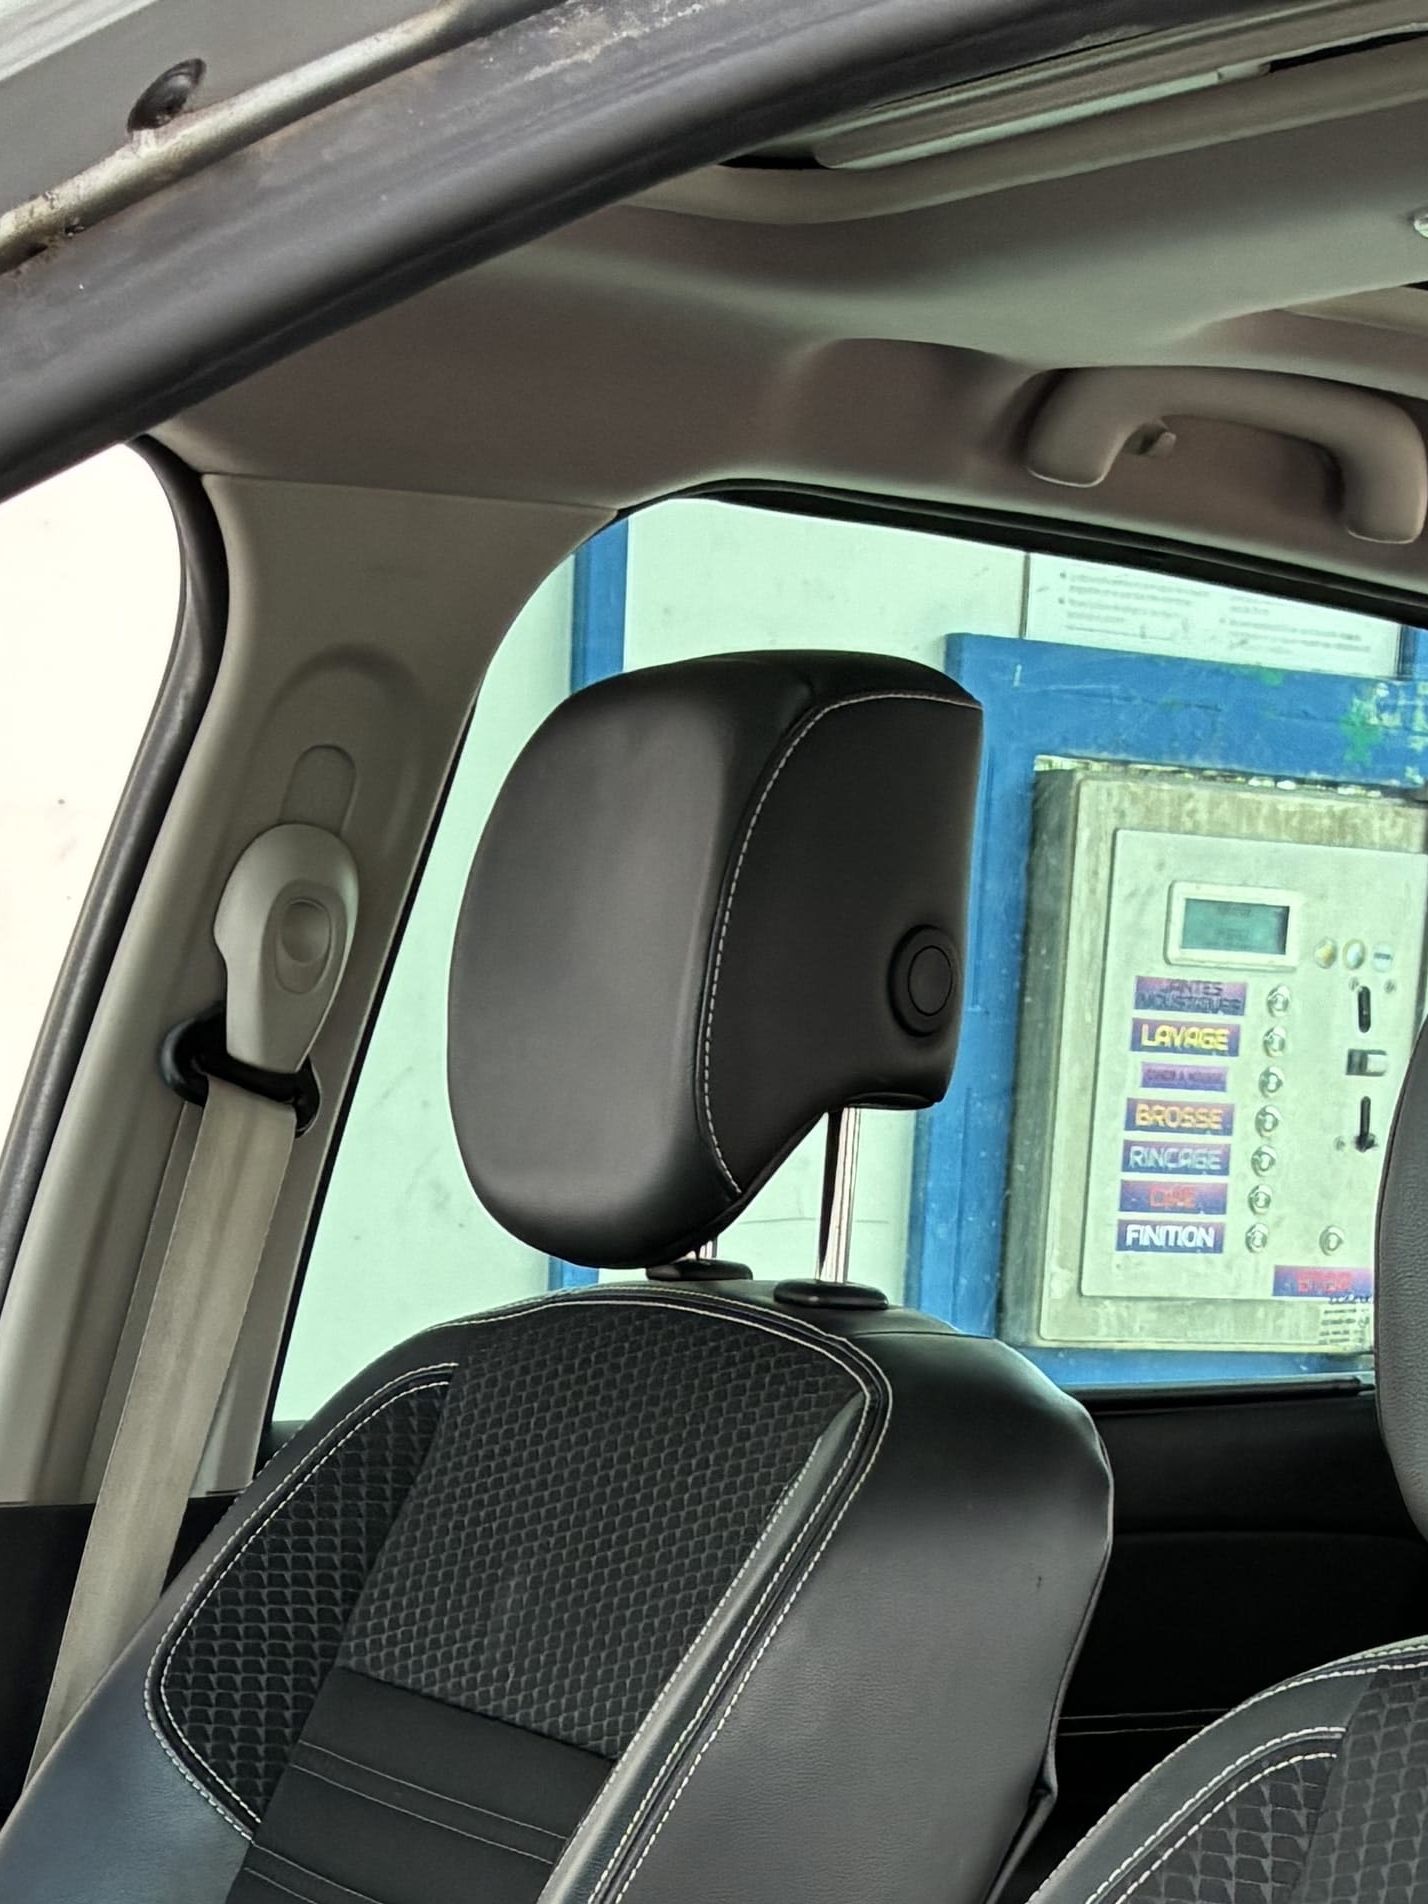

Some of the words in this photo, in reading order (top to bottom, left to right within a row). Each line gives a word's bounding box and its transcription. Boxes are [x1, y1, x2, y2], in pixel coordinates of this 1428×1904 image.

[1140, 1023, 1230, 1051] LAVAGE
[1135, 1103, 1224, 1130] BROSSE
[1129, 1145, 1222, 1171] RINCAGE
[1125, 1224, 1215, 1249] FINITION
